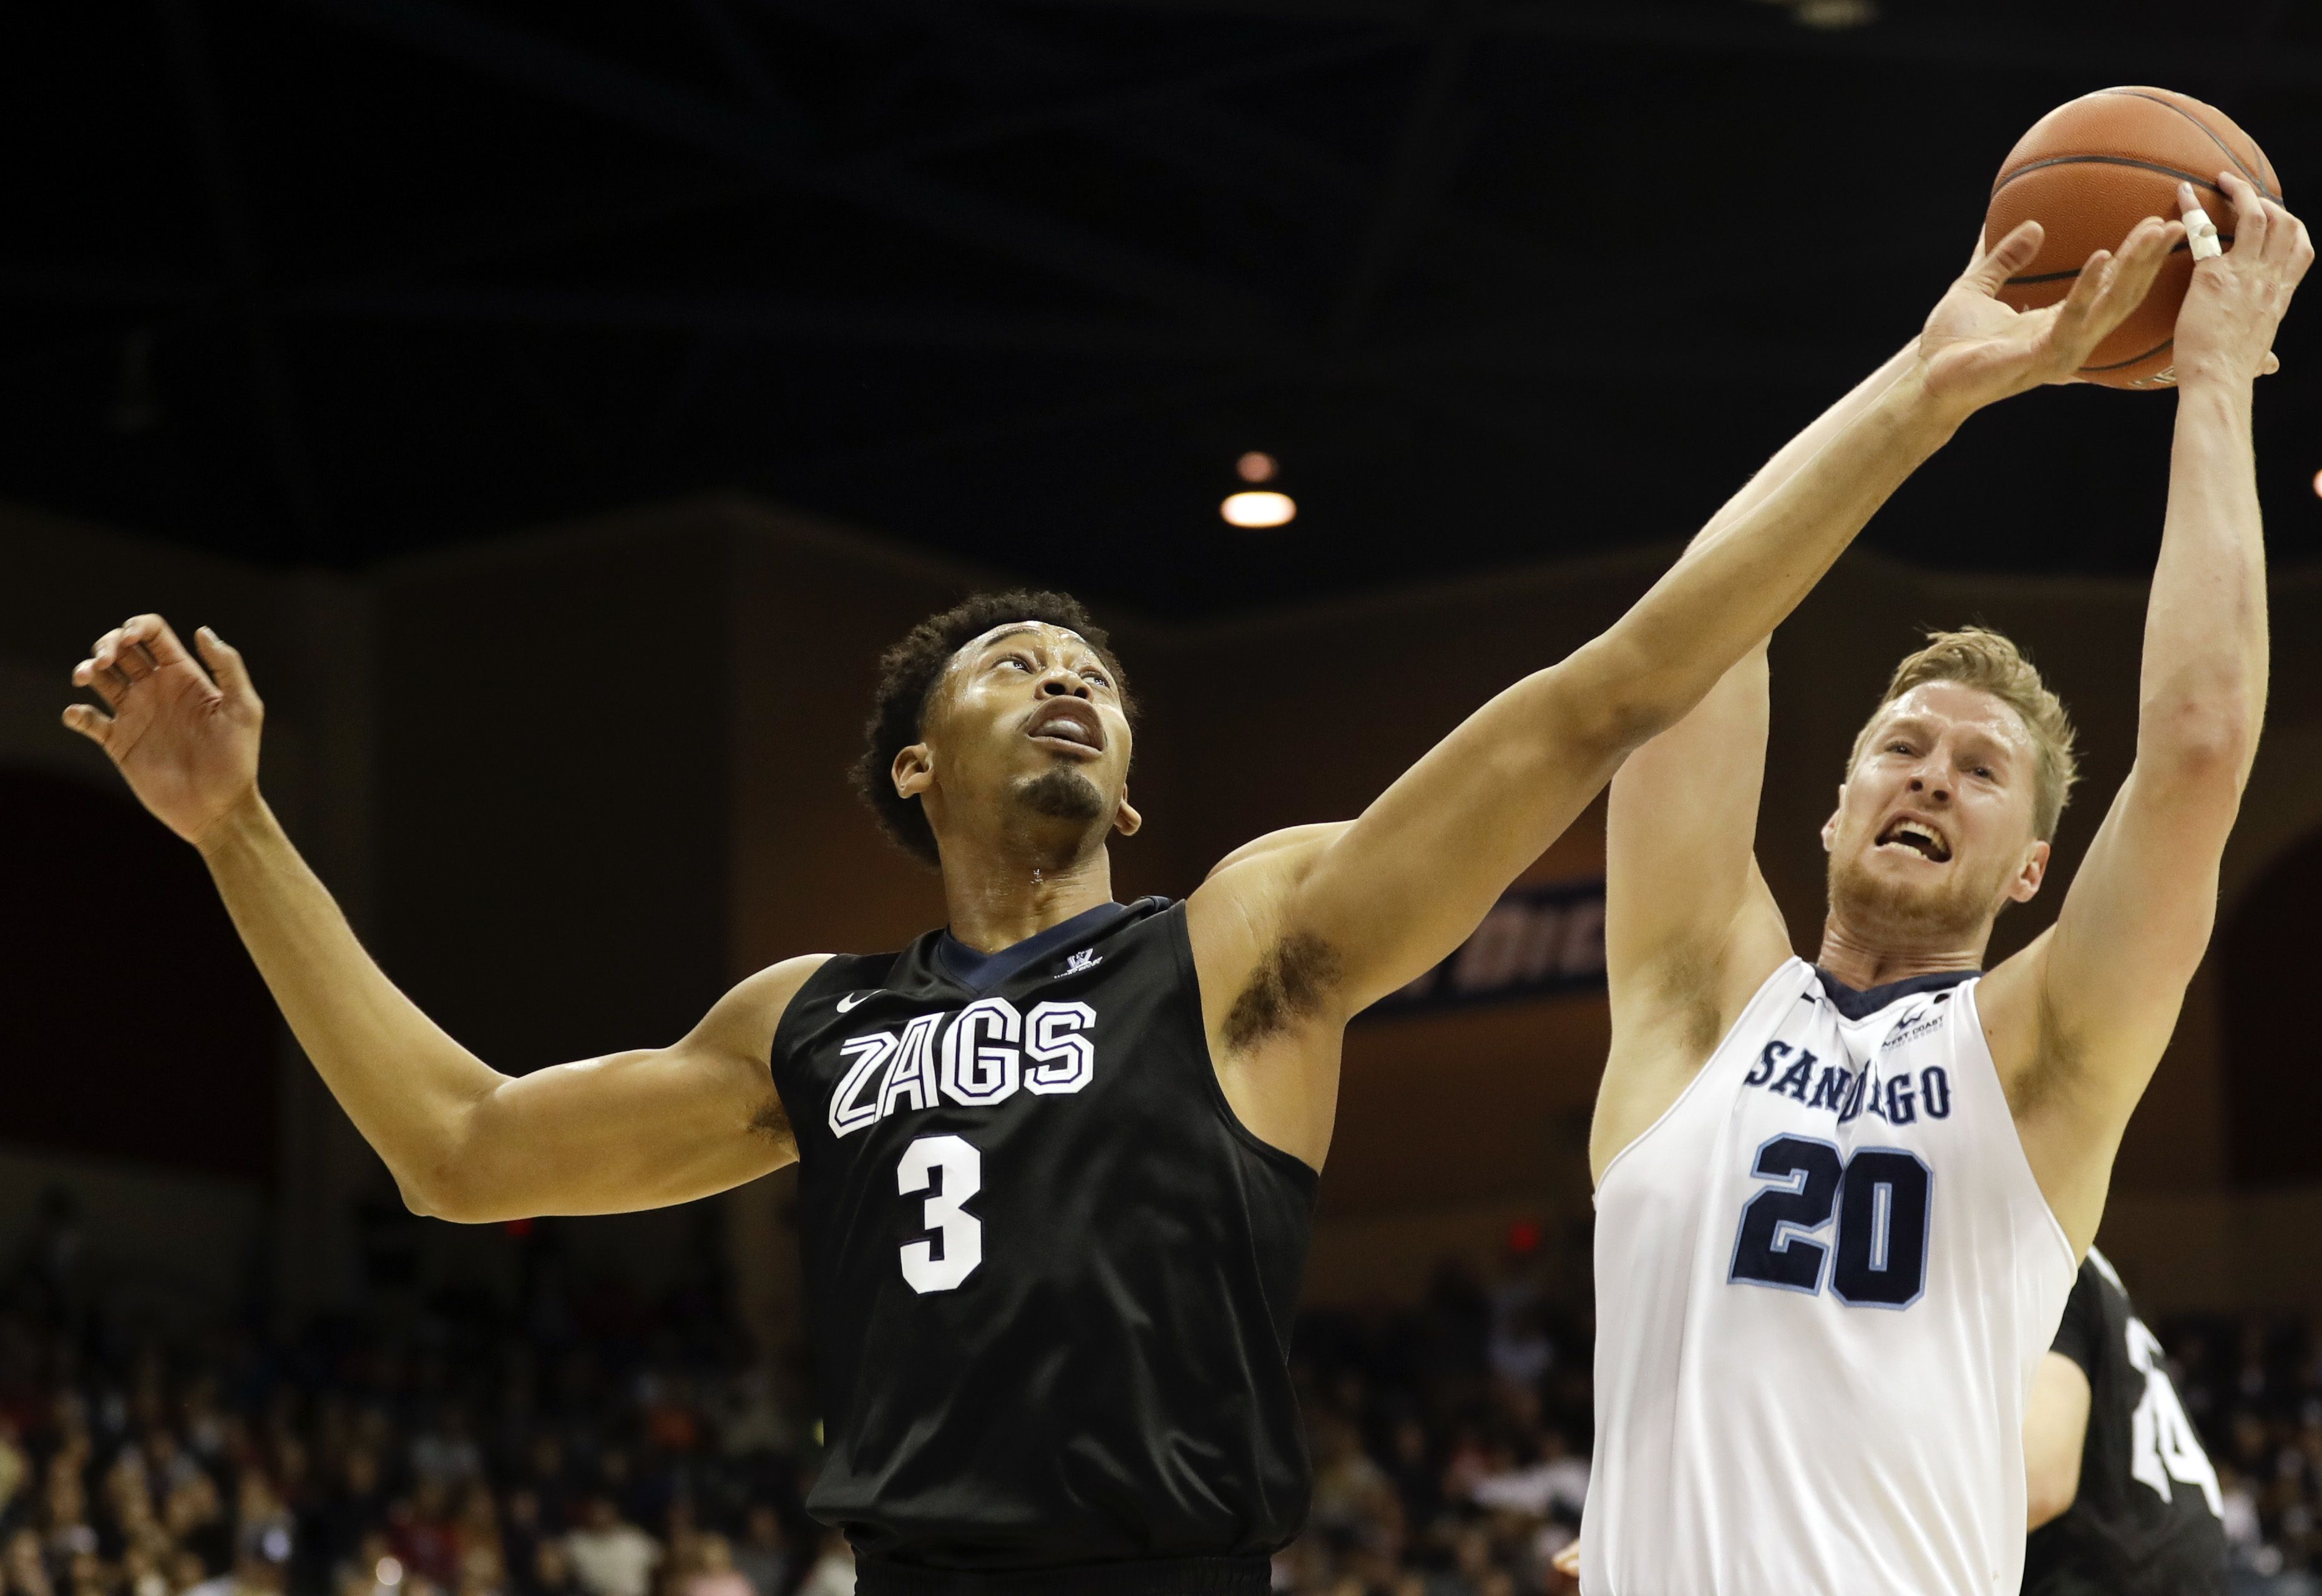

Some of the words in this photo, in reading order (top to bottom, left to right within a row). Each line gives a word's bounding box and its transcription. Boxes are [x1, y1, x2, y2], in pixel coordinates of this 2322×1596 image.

[828, 997, 1096, 1139] ZAGS
[1744, 1040, 1852, 1112] SAN
[897, 1134, 983, 1295] 3
[1727, 1132, 1933, 1311] 20
